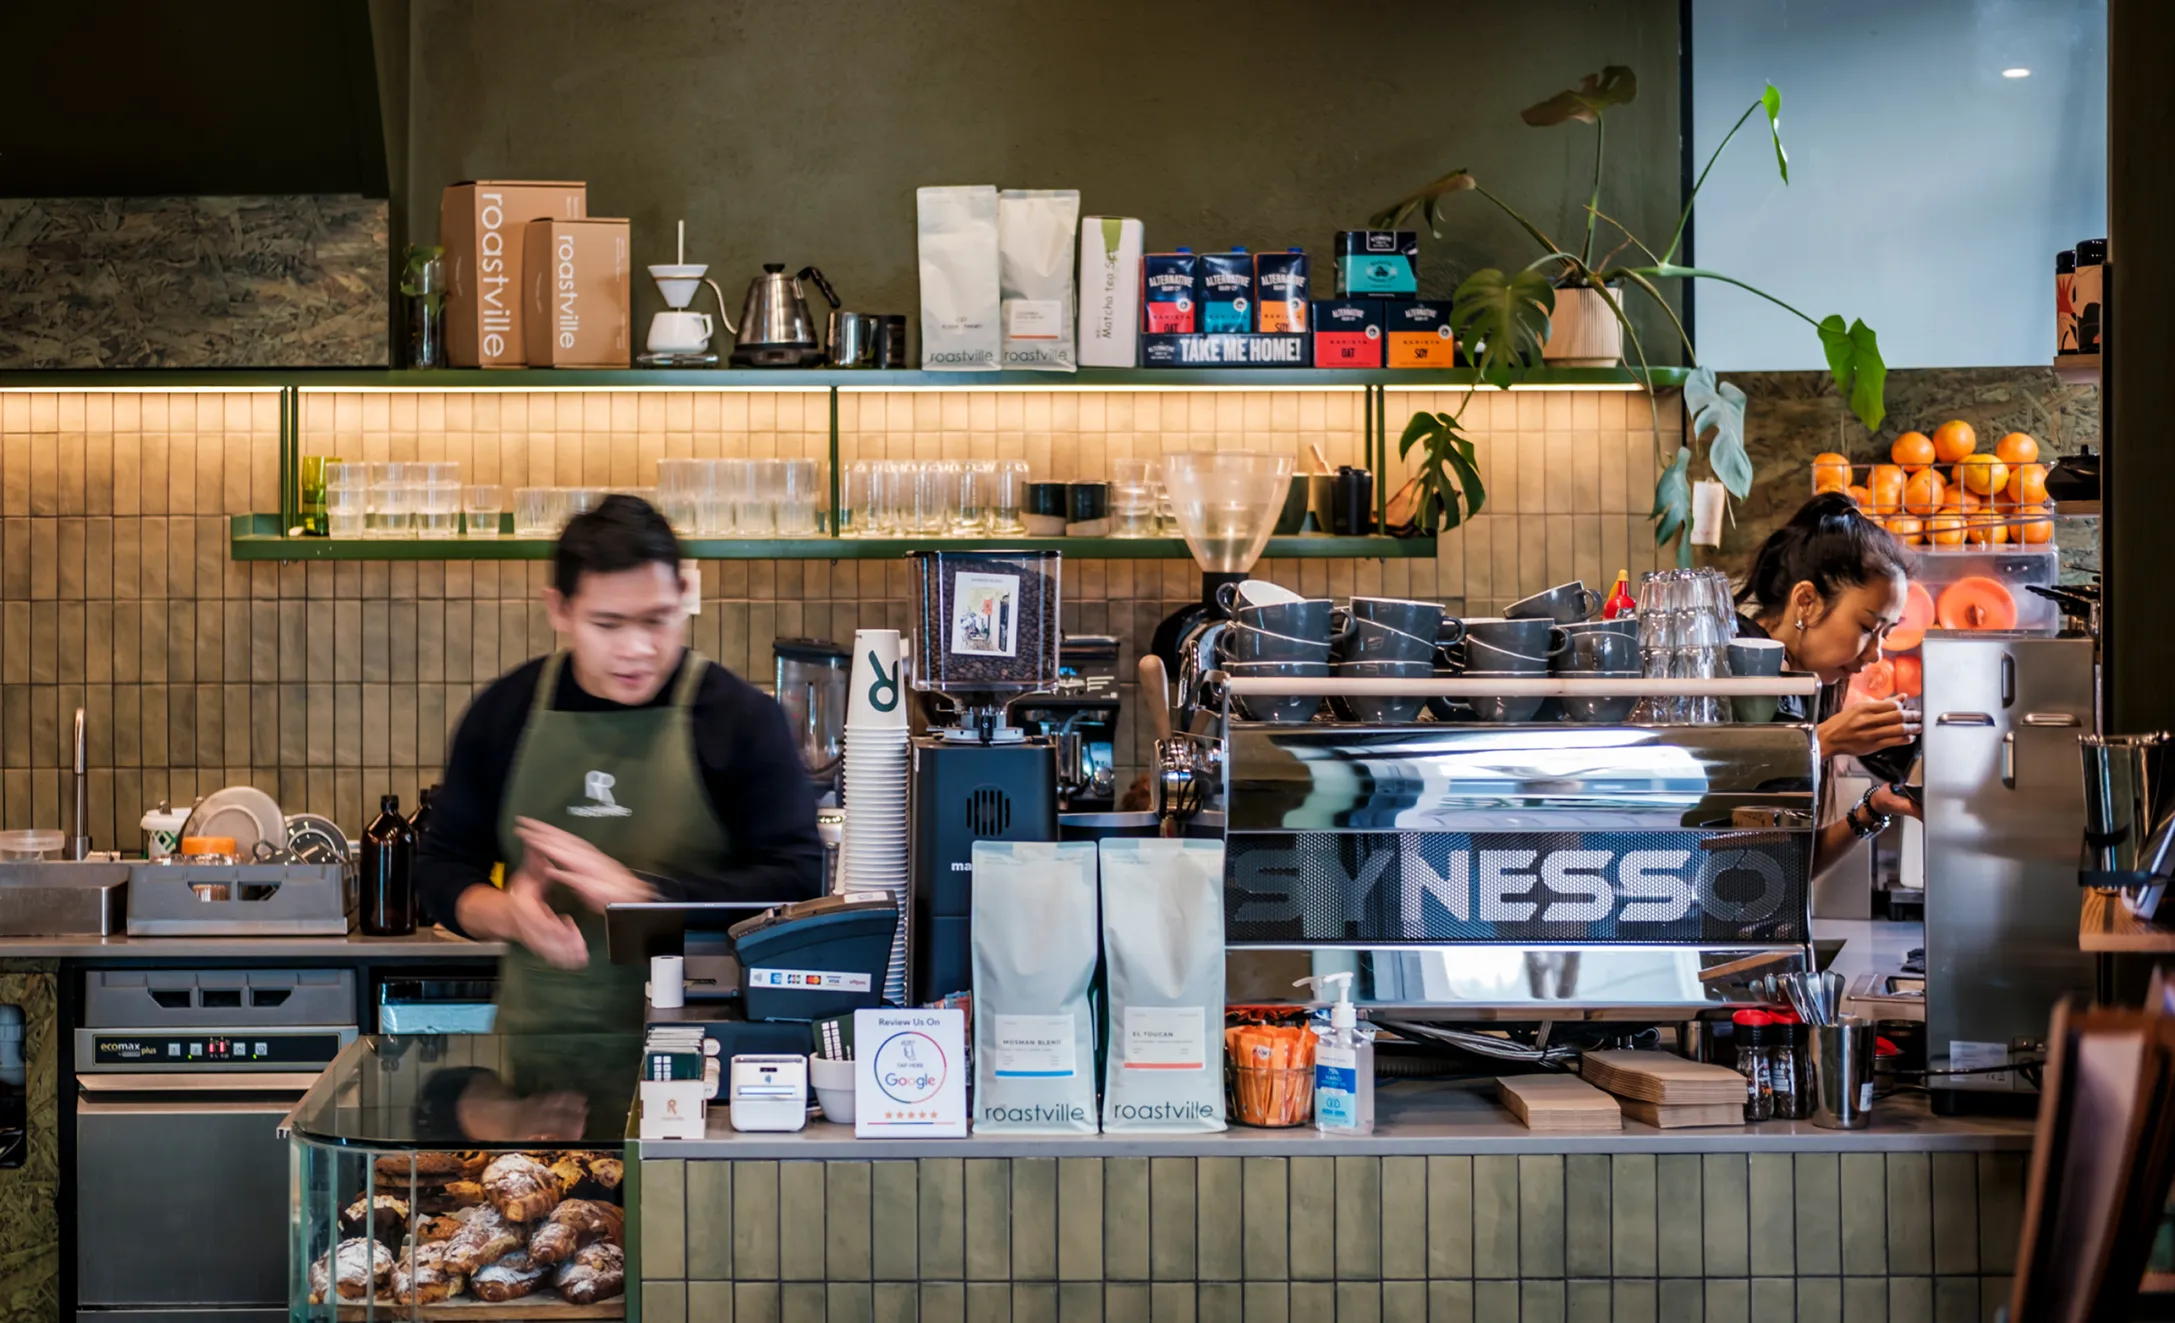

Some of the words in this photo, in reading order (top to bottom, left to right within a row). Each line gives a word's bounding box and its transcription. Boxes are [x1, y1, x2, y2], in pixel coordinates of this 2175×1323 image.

[481, 193, 511, 358] roastville
[1148, 274, 1194, 288] ALTERNATIVE
[558, 235, 579, 349] roastville
[1102, 295, 1114, 339] Matcha
[930, 350, 994, 364] roastville
[1003, 349, 1069, 363] roastville
[1180, 338, 1221, 362] TAKE
[1223, 338, 1248, 362] ME
[1249, 337, 1302, 362] HOME!
[1341, 347, 1356, 359] OAT
[1414, 347, 1429, 359] SOY
[1233, 848, 1787, 922] SYNESSO
[878, 1018, 911, 1026] Review
[913, 1018, 925, 1026] Us
[926, 1018, 941, 1026] On
[100, 1042, 141, 1051] ecomax
[141, 1046, 157, 1056] plus
[884, 1072, 936, 1090] Google
[985, 1103, 1085, 1123] roastville
[1114, 1101, 1214, 1120] roastville
